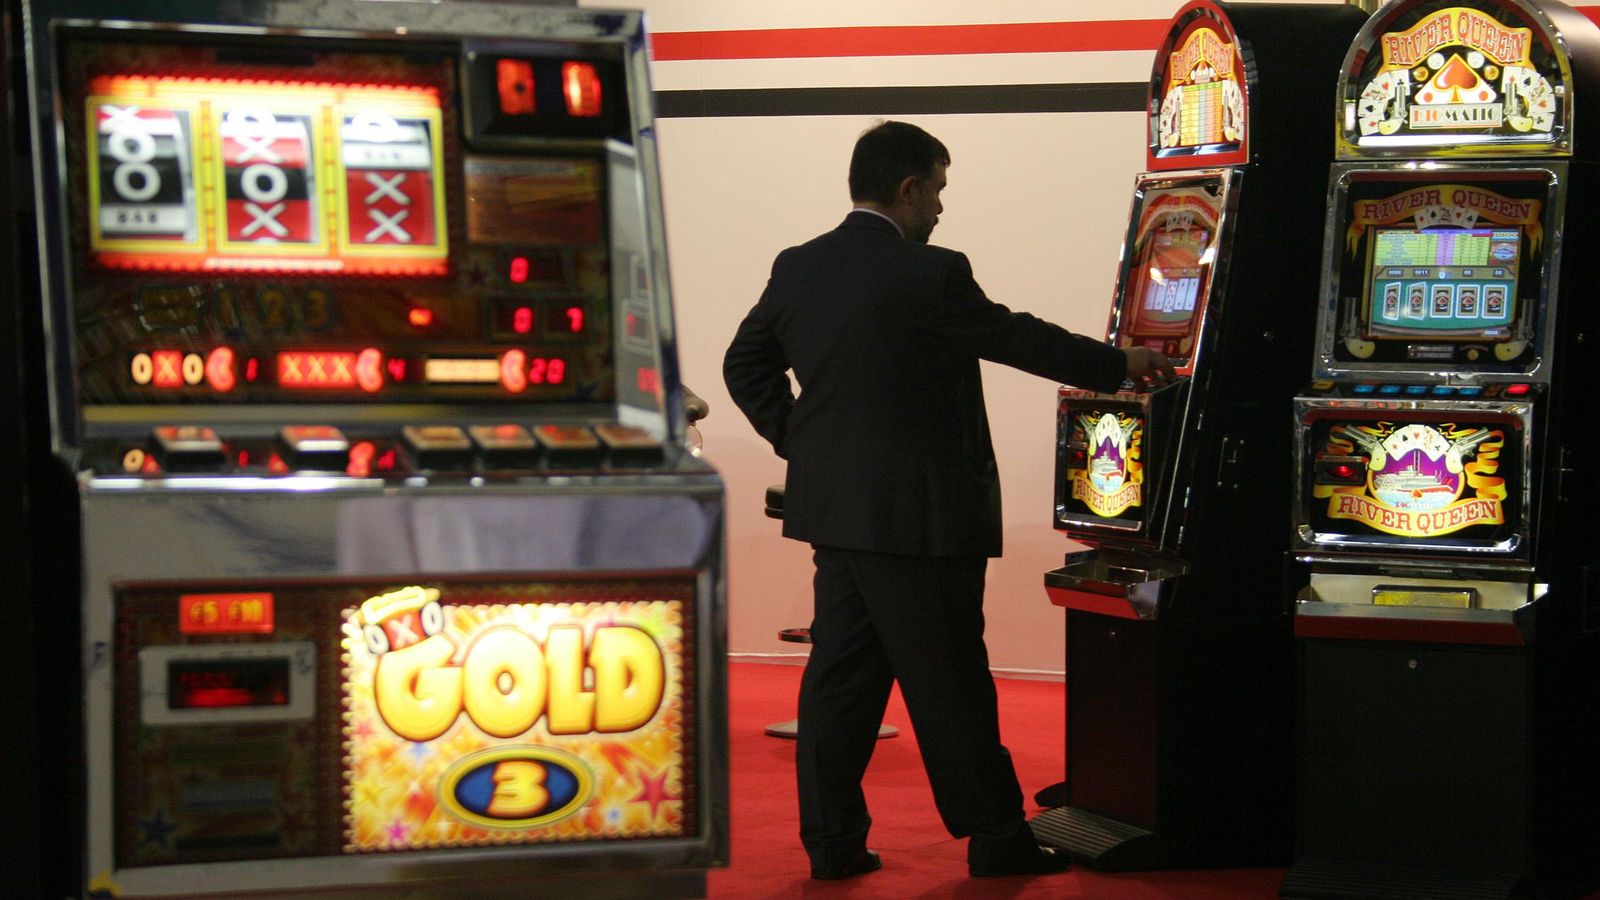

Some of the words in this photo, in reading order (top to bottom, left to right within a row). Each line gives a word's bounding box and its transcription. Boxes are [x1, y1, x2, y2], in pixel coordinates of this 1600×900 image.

[1387, 13, 1453, 65] RIVER
[1457, 11, 1527, 63] QUEEN
[1362, 190, 1443, 220] RIVER
[1452, 189, 1532, 220] QUEEN
[1074, 479, 1105, 510] RIVER
[1107, 483, 1141, 514] QUEEN
[1337, 495, 1412, 531] RIVER
[1416, 500, 1498, 534] QUEEN
[374, 624, 666, 742] GOLD
[486, 758, 549, 819] 3
